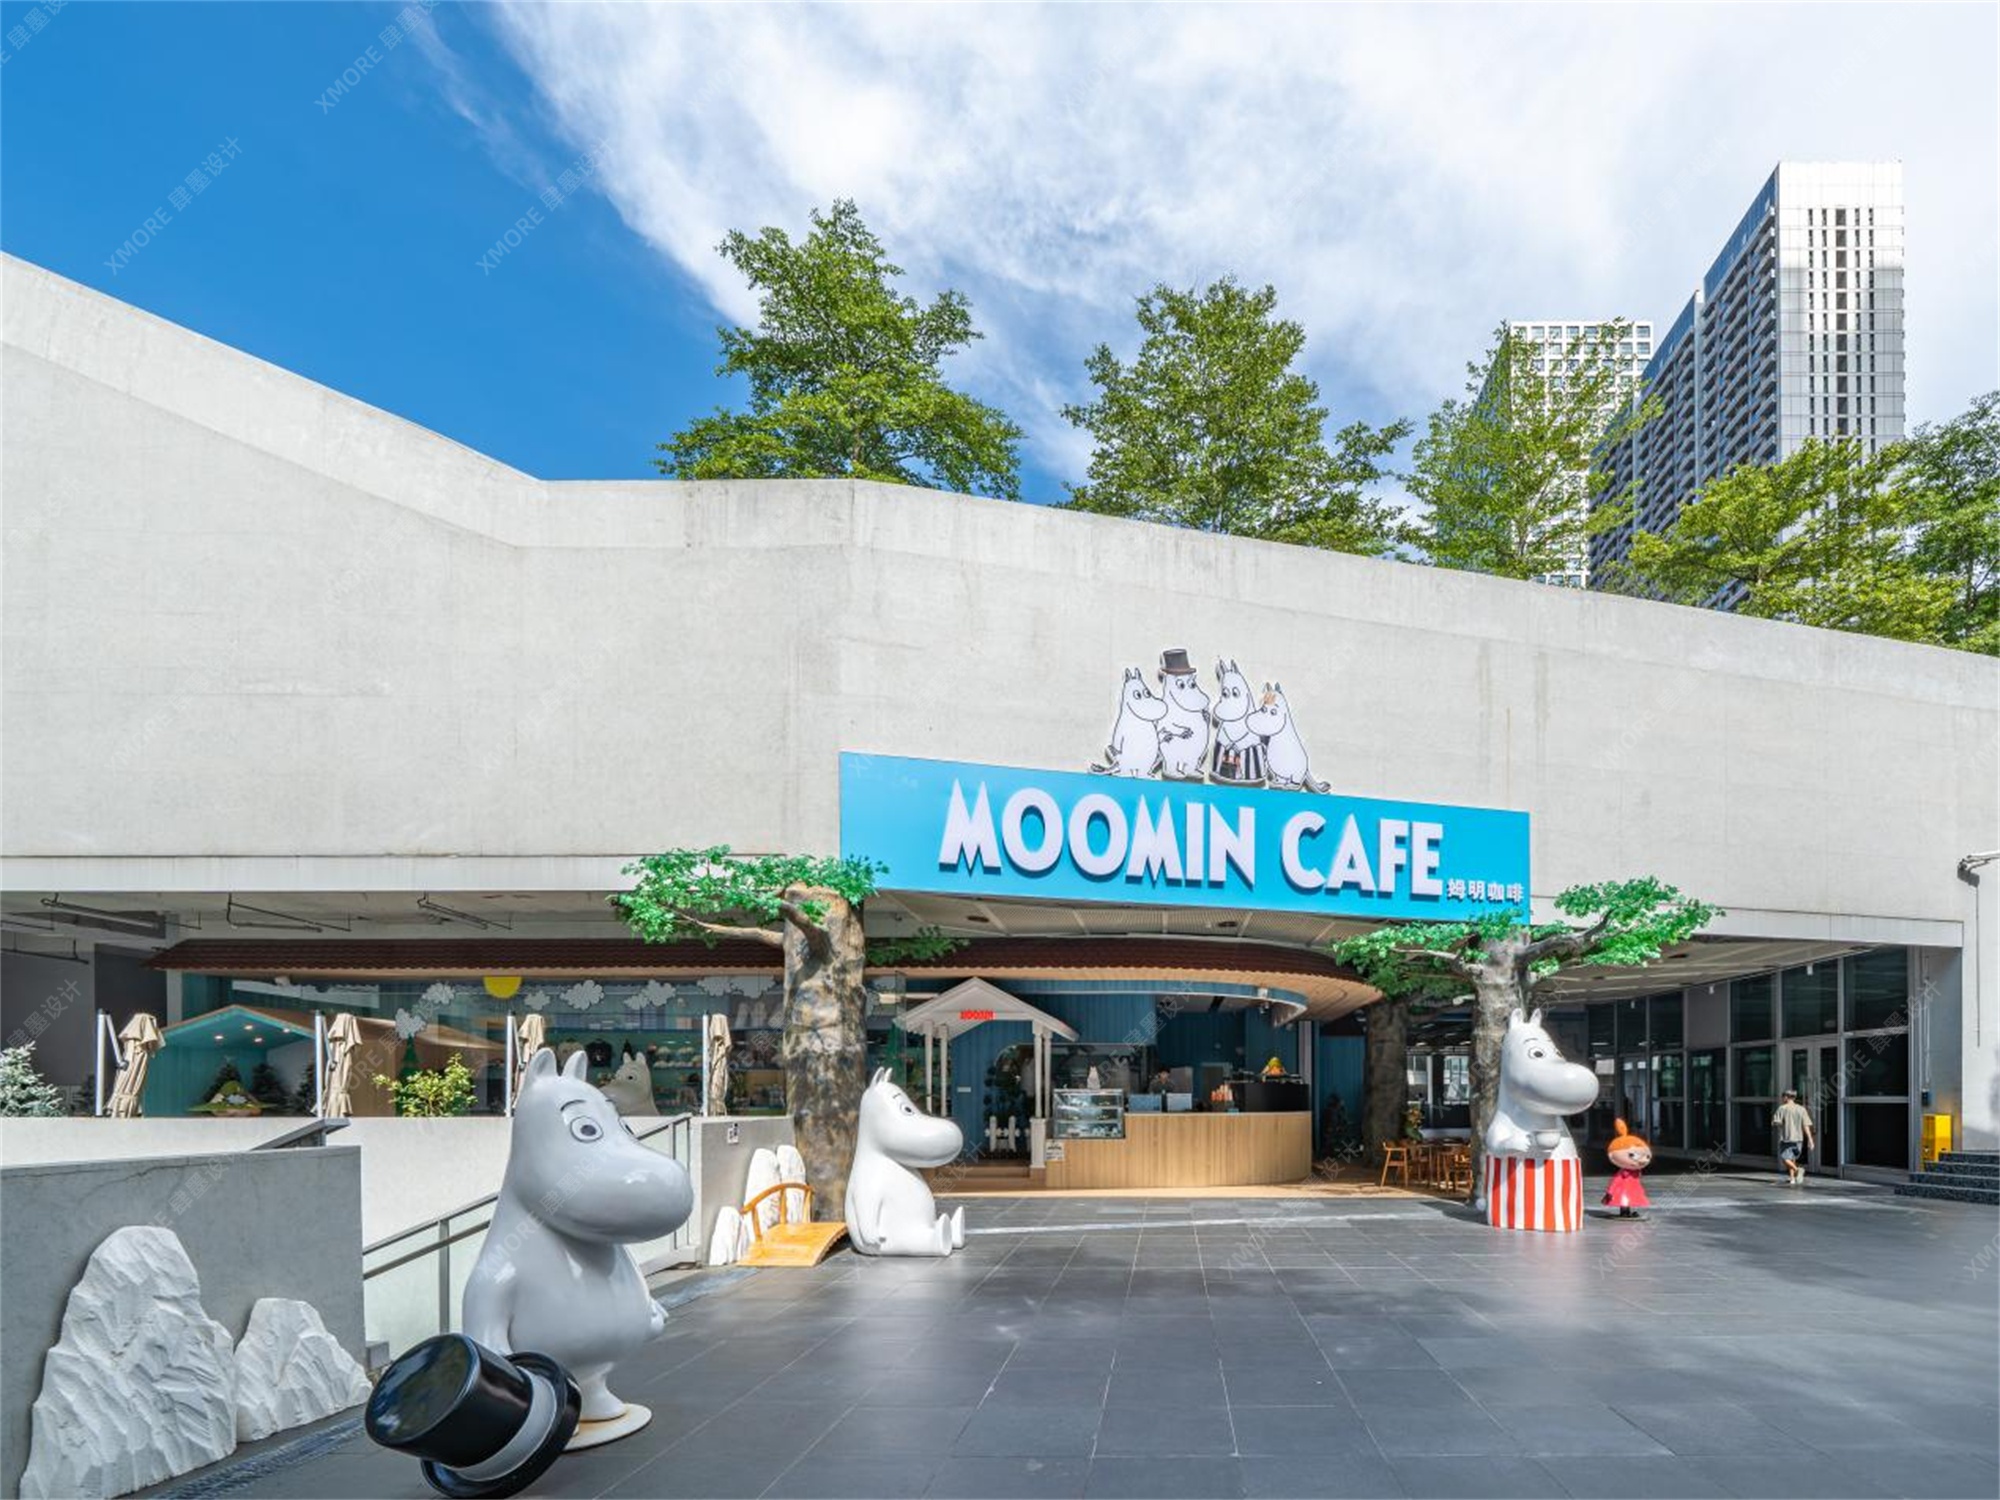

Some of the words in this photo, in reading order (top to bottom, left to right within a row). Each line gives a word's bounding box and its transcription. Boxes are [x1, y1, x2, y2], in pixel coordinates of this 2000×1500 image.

[938, 778, 1256, 890] MOOMIN
[1280, 811, 1444, 901] CAFE
[1447, 880, 1524, 905] 姆明咖啡
